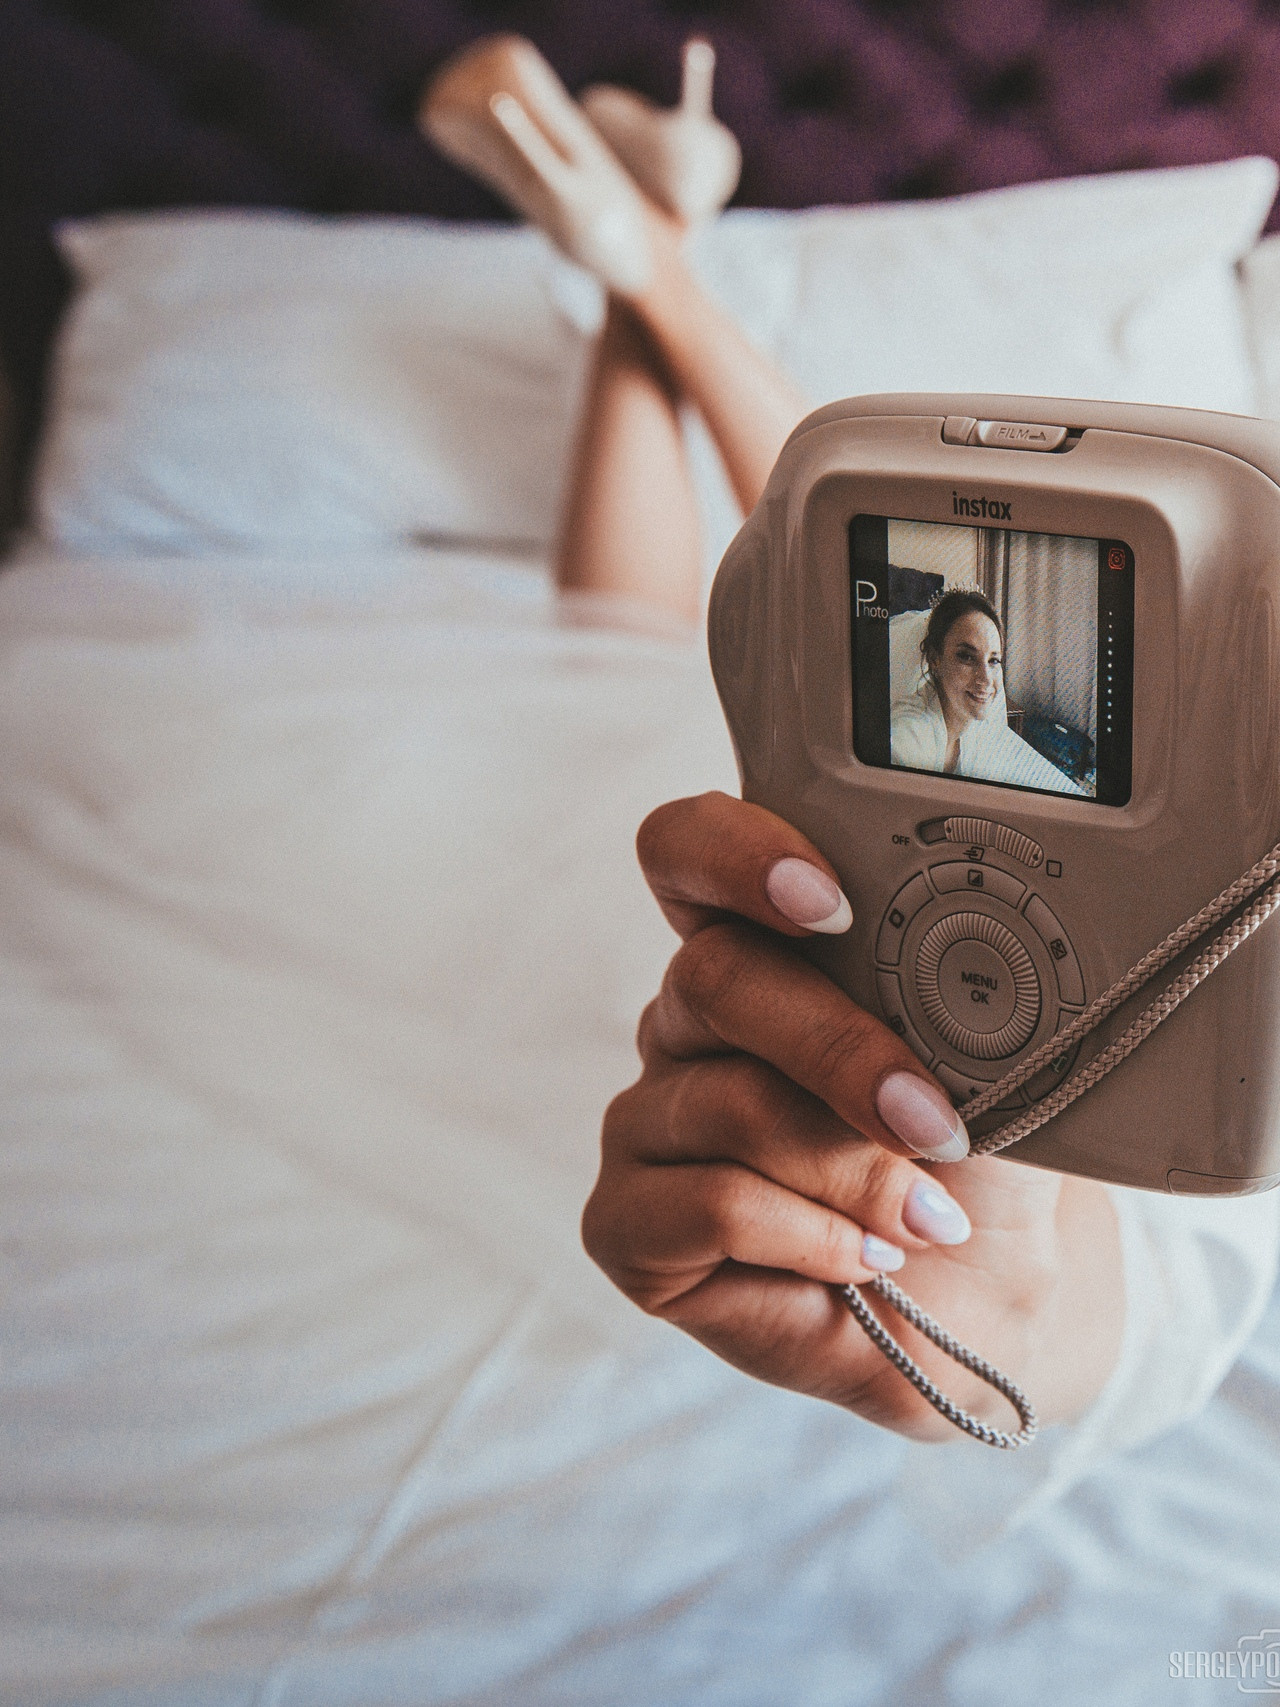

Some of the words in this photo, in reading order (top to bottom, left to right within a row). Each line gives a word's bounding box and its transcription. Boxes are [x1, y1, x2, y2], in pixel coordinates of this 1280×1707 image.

[997, 427, 1029, 440] FILM
[952, 491, 1012, 520] instax
[855, 580, 889, 619] Photo
[892, 834, 910, 846] OFF
[961, 971, 998, 991] MENU
[970, 990, 990, 1005] OK
